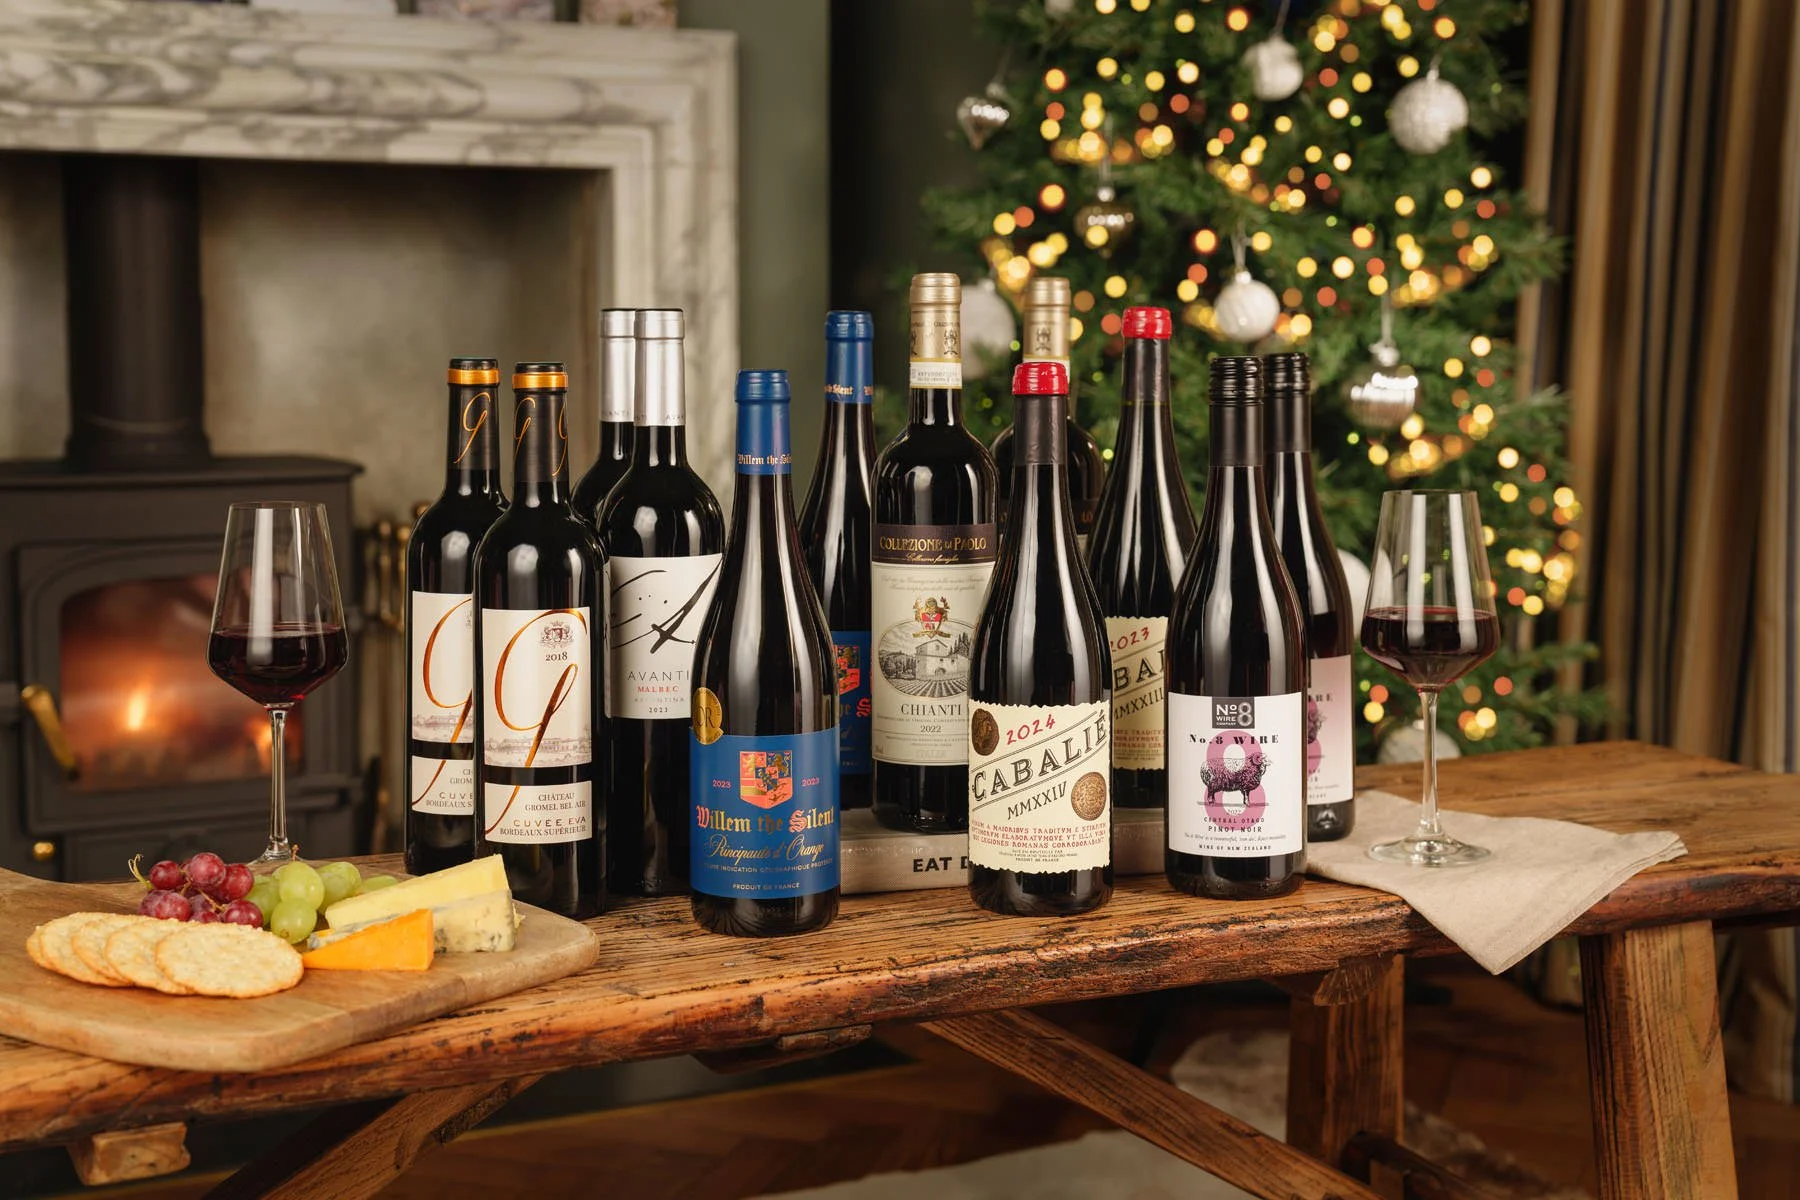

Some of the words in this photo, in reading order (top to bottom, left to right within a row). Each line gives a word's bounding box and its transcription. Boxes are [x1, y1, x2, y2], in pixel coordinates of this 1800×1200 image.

[879, 536, 942, 551] COLLEZIONE
[952, 536, 987, 550] PAOLO
[545, 651, 568, 661] 2018
[627, 669, 690, 681] AVANTI
[637, 685, 679, 693] MALBEC
[901, 703, 961, 716] CHIANTI
[919, 725, 942, 733] 2022
[1006, 714, 1056, 745] 2024
[1233, 735, 1279, 745] WIRE
[972, 709, 1107, 801] CABALIÉ
[712, 780, 732, 788] 2023
[801, 778, 819, 787] 2023
[538, 792, 575, 802] CHÂTEAU
[1007, 781, 1067, 820] MMXXIV
[525, 803, 558, 811] GROMEL
[568, 816, 586, 824] EVA
[697, 805, 752, 833] Willem
[756, 814, 784, 835] the
[1204, 816, 1237, 824] CENTRAL
[499, 828, 542, 836] BORDEAUX
[1012, 841, 1048, 849] ROMANAS
[912, 857, 952, 872] EAT
[733, 883, 762, 891] PRODUIT
